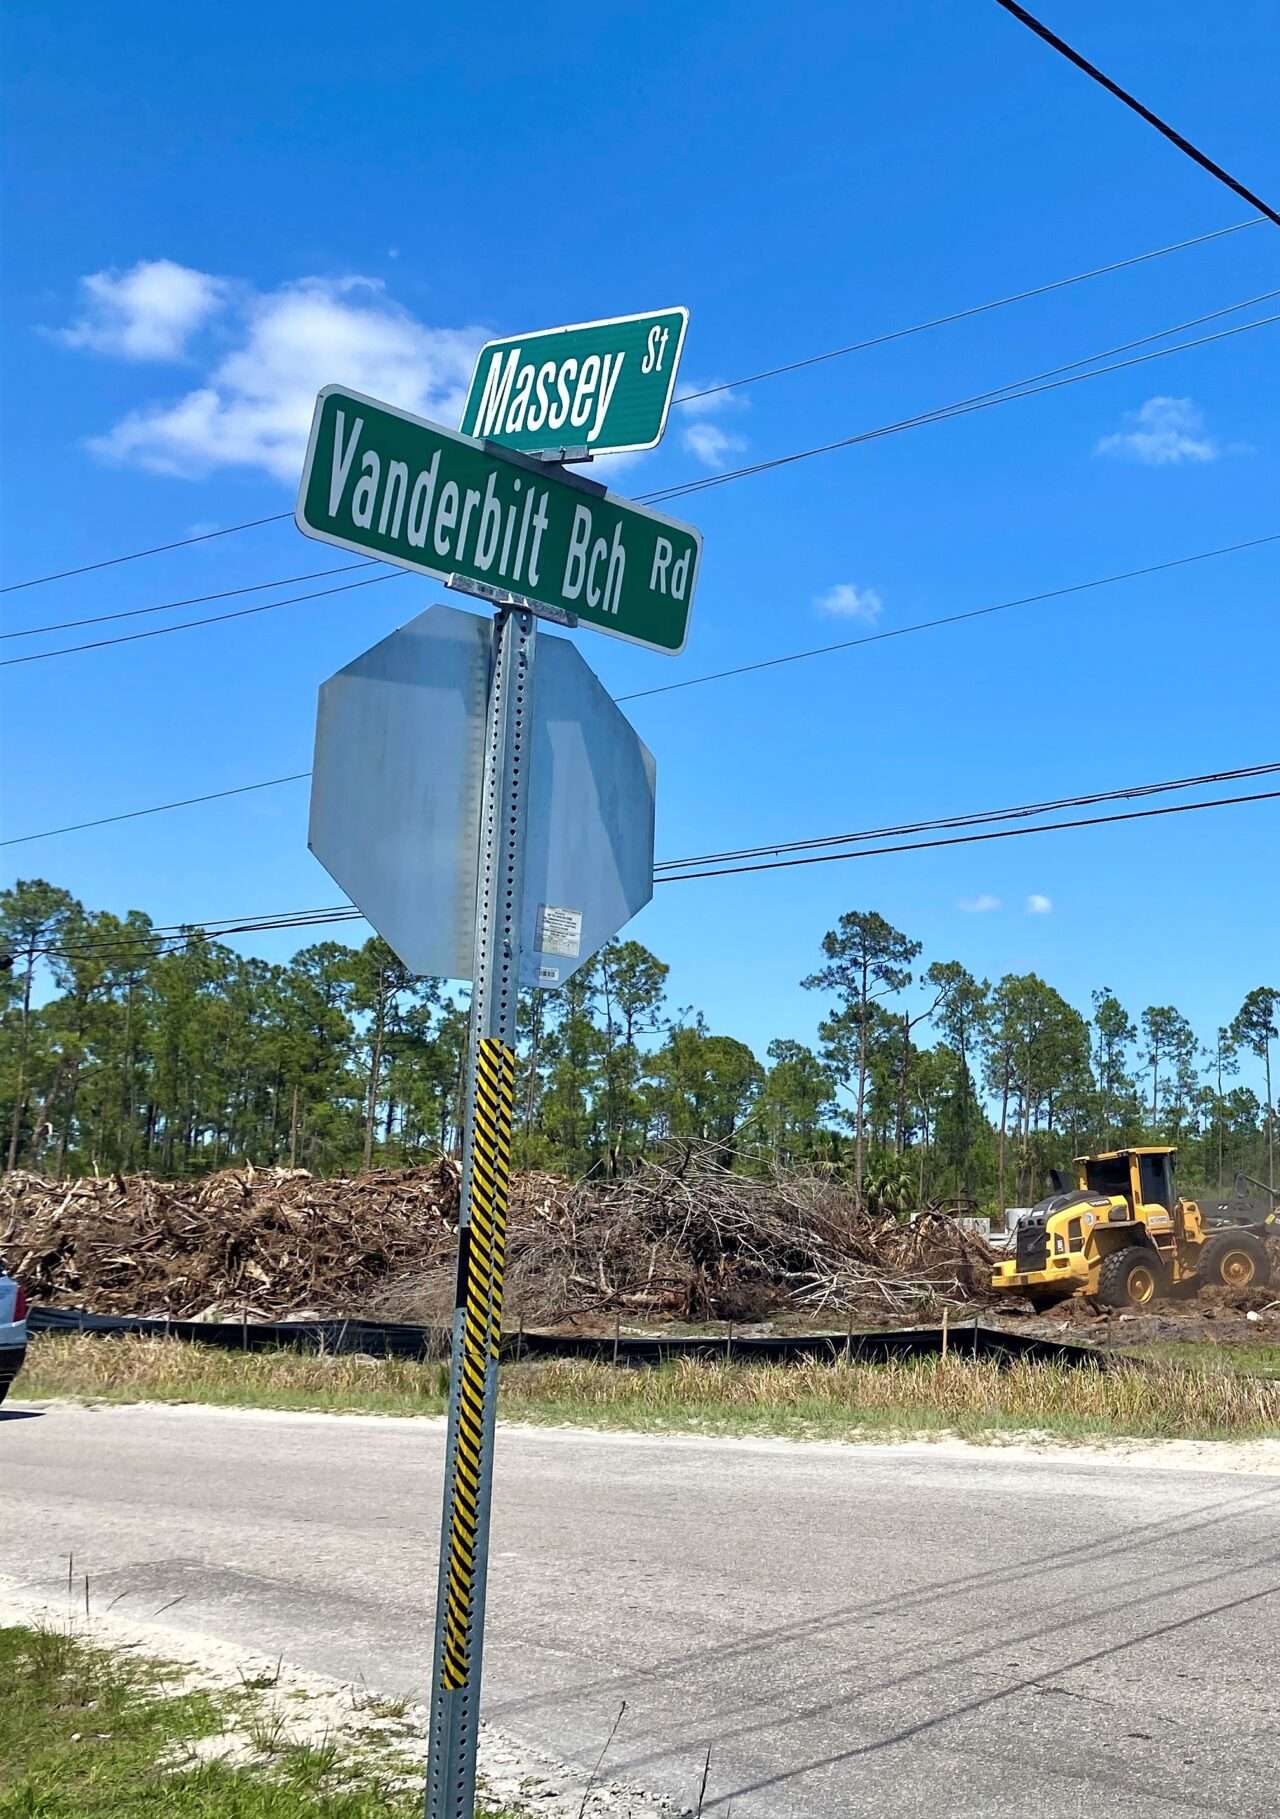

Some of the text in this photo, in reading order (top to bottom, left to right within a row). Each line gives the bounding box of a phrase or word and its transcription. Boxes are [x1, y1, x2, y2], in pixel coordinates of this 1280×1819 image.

[473, 325, 669, 442] Massey St
[327, 410, 692, 615] Vanderbilt Bch Rd
